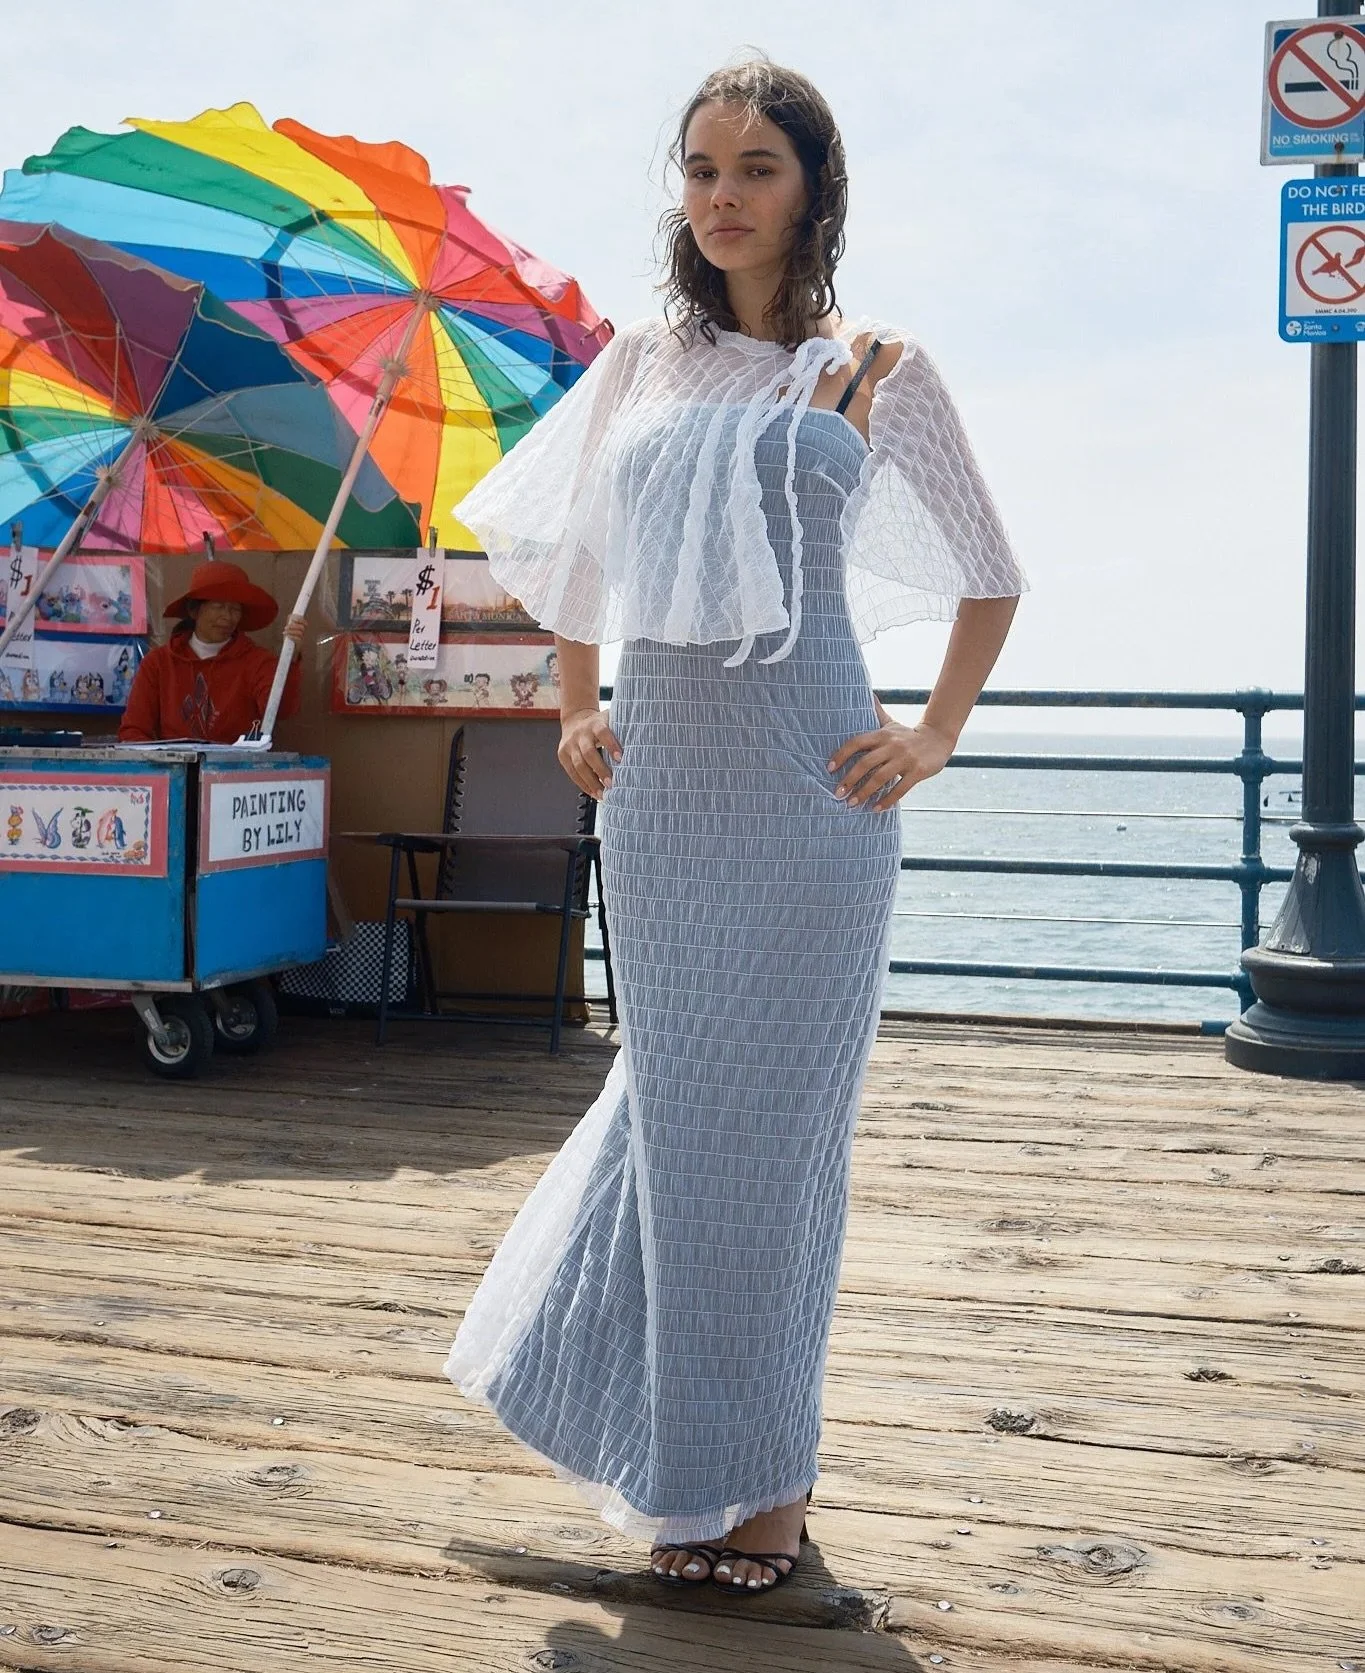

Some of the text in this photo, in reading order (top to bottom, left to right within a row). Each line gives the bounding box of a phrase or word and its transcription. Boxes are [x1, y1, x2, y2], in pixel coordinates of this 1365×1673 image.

[1272, 135, 1290, 145] NO
[1292, 132, 1349, 145] SMOKING
[1288, 186, 1311, 199] DO
[1315, 184, 1348, 198] NOT
[1301, 203, 1328, 216] THE
[412, 617, 426, 634] Per
[409, 639, 437, 651] Letter
[232, 788, 306, 820] PAINTING
[243, 818, 302, 852] BY LILY
